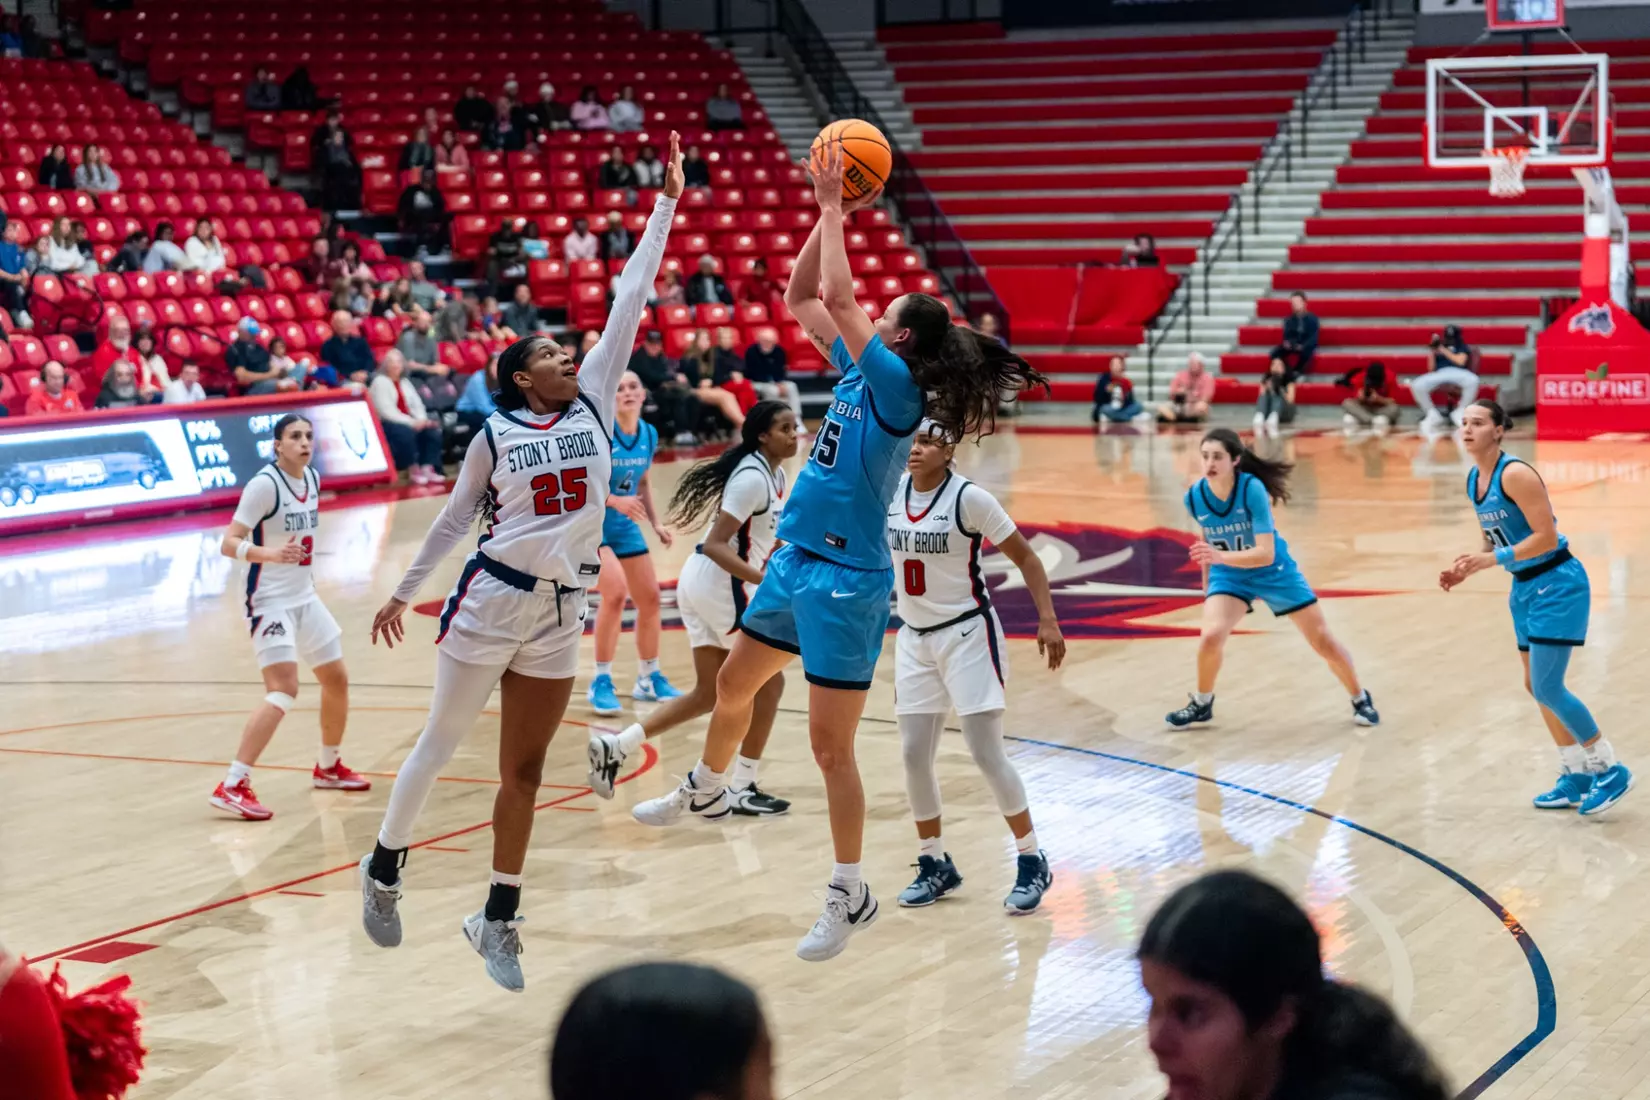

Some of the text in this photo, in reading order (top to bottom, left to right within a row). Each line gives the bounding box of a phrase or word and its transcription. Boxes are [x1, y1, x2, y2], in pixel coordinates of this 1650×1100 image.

[1544, 381, 1645, 398] REDEFINE
[567, 407, 585, 419] CAA
[508, 431, 598, 472] STONY BROOK
[530, 466, 587, 516] 25
[615, 470, 634, 495] 4
[285, 512, 308, 531] STONY
[915, 532, 949, 554] BROOK
[903, 559, 926, 596] 0
